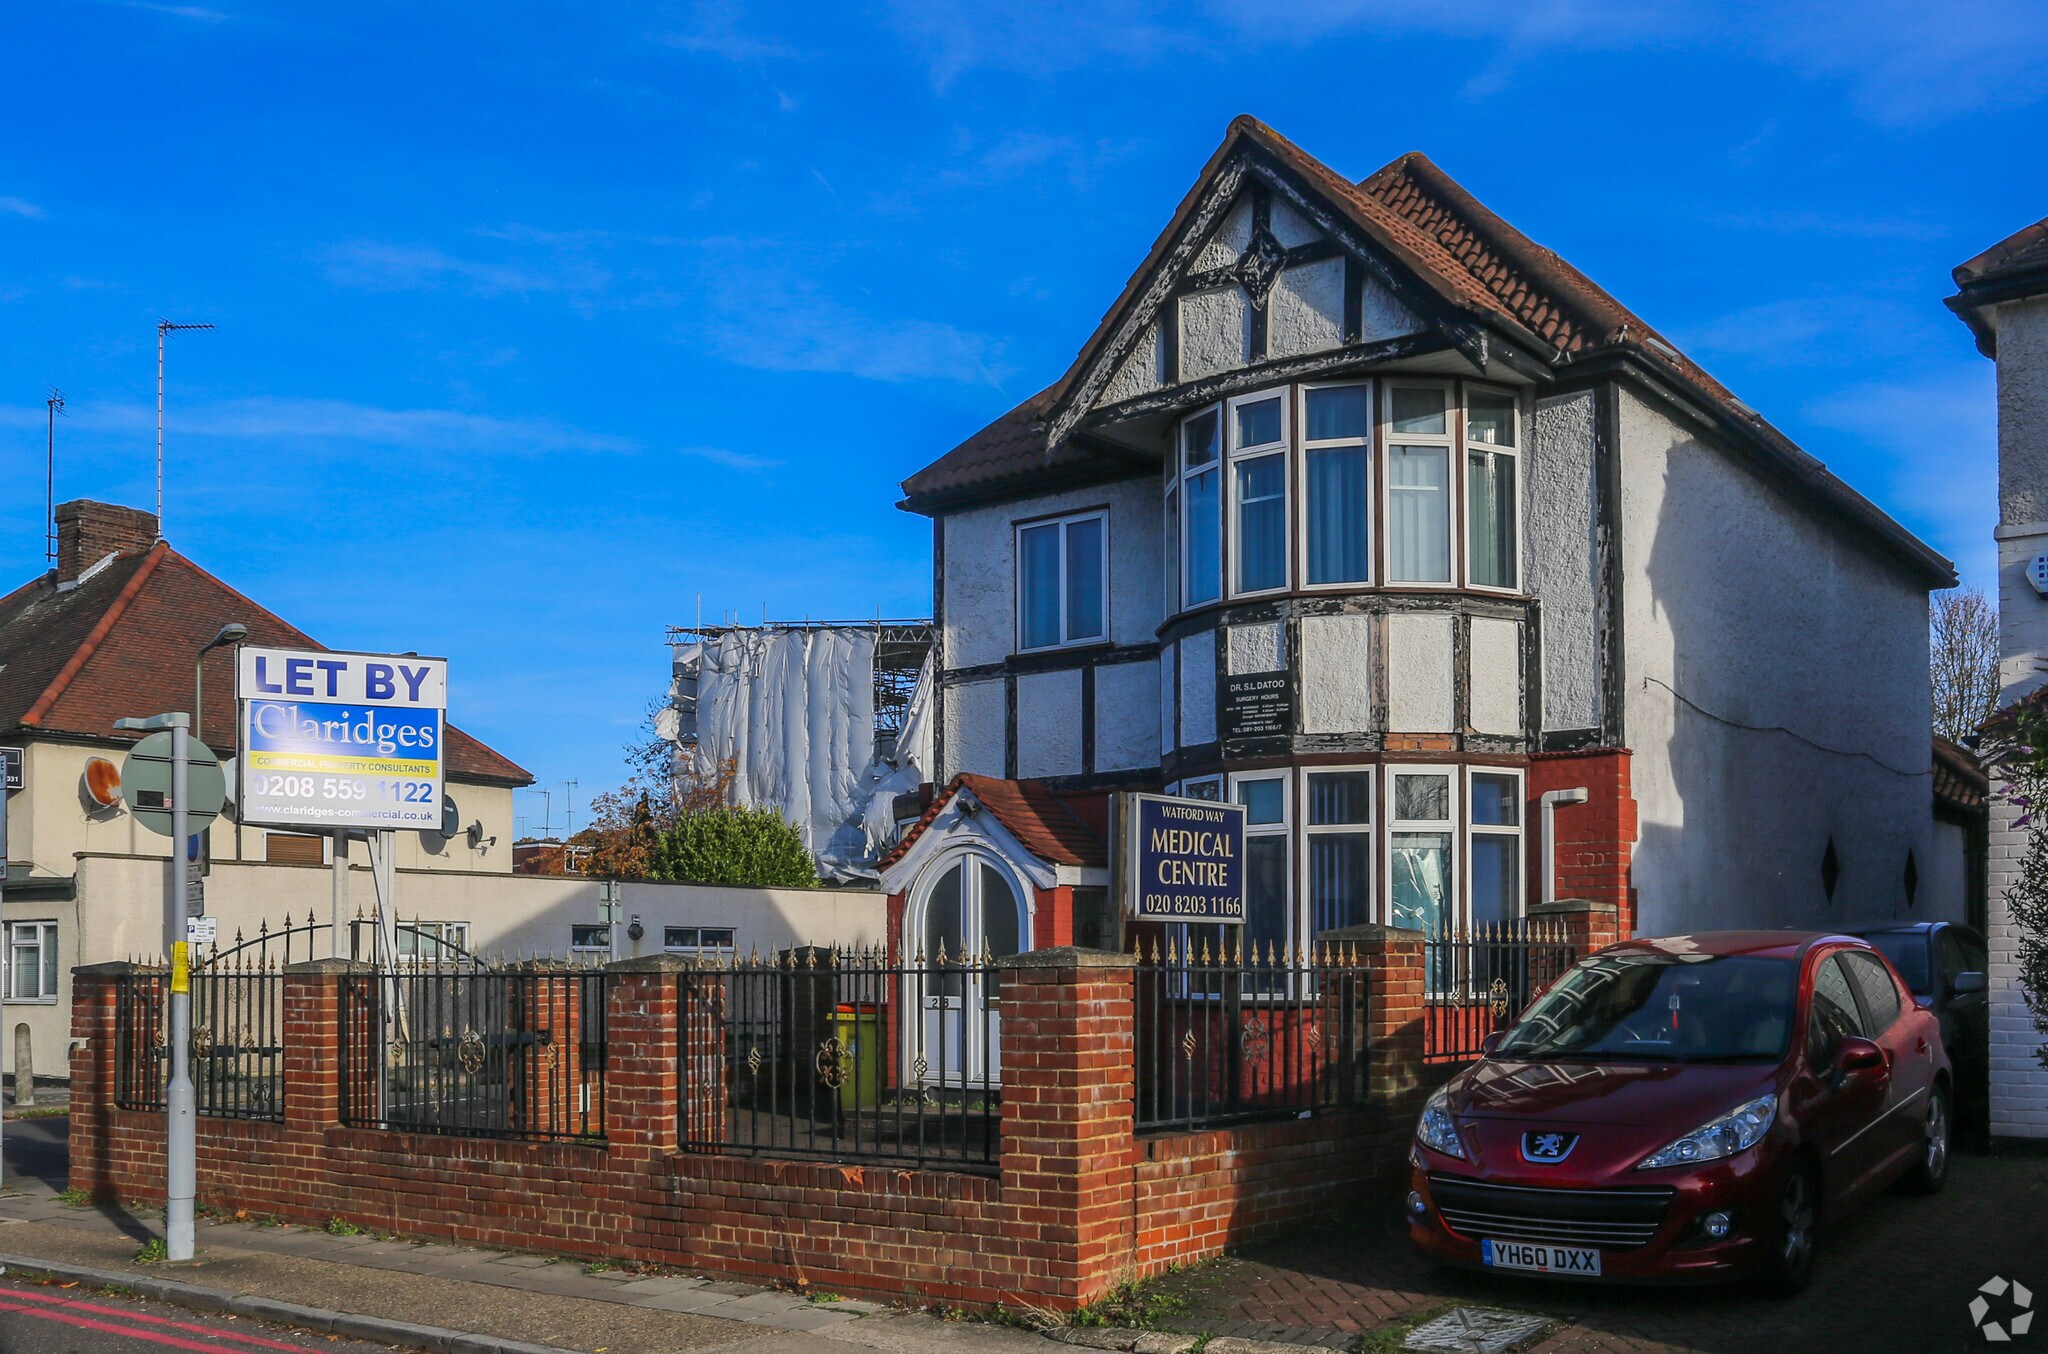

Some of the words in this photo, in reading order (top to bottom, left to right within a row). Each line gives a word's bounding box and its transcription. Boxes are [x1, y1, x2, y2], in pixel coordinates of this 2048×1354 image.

[255, 656, 348, 698] LET
[365, 662, 431, 702] BY
[1230, 684, 1243, 692] DR.
[254, 704, 434, 754] Claridges
[257, 757, 316, 768] COMERCIAL
[368, 763, 430, 774] CONSULTANTS
[255, 775, 315, 798] 0208
[322, 778, 366, 800] 559
[376, 780, 433, 803] 1122
[1162, 806, 1204, 821] WATFORD
[1206, 810, 1225, 822] WAY
[1151, 828, 1234, 858] MEDICAL
[1158, 860, 1228, 887] CENTRE
[1146, 894, 1171, 913] 020
[1175, 895, 1206, 914] 8203
[1210, 896, 1241, 915] 1166
[1495, 1243, 1548, 1267] YH60
[1554, 1249, 1595, 1271] DXX
